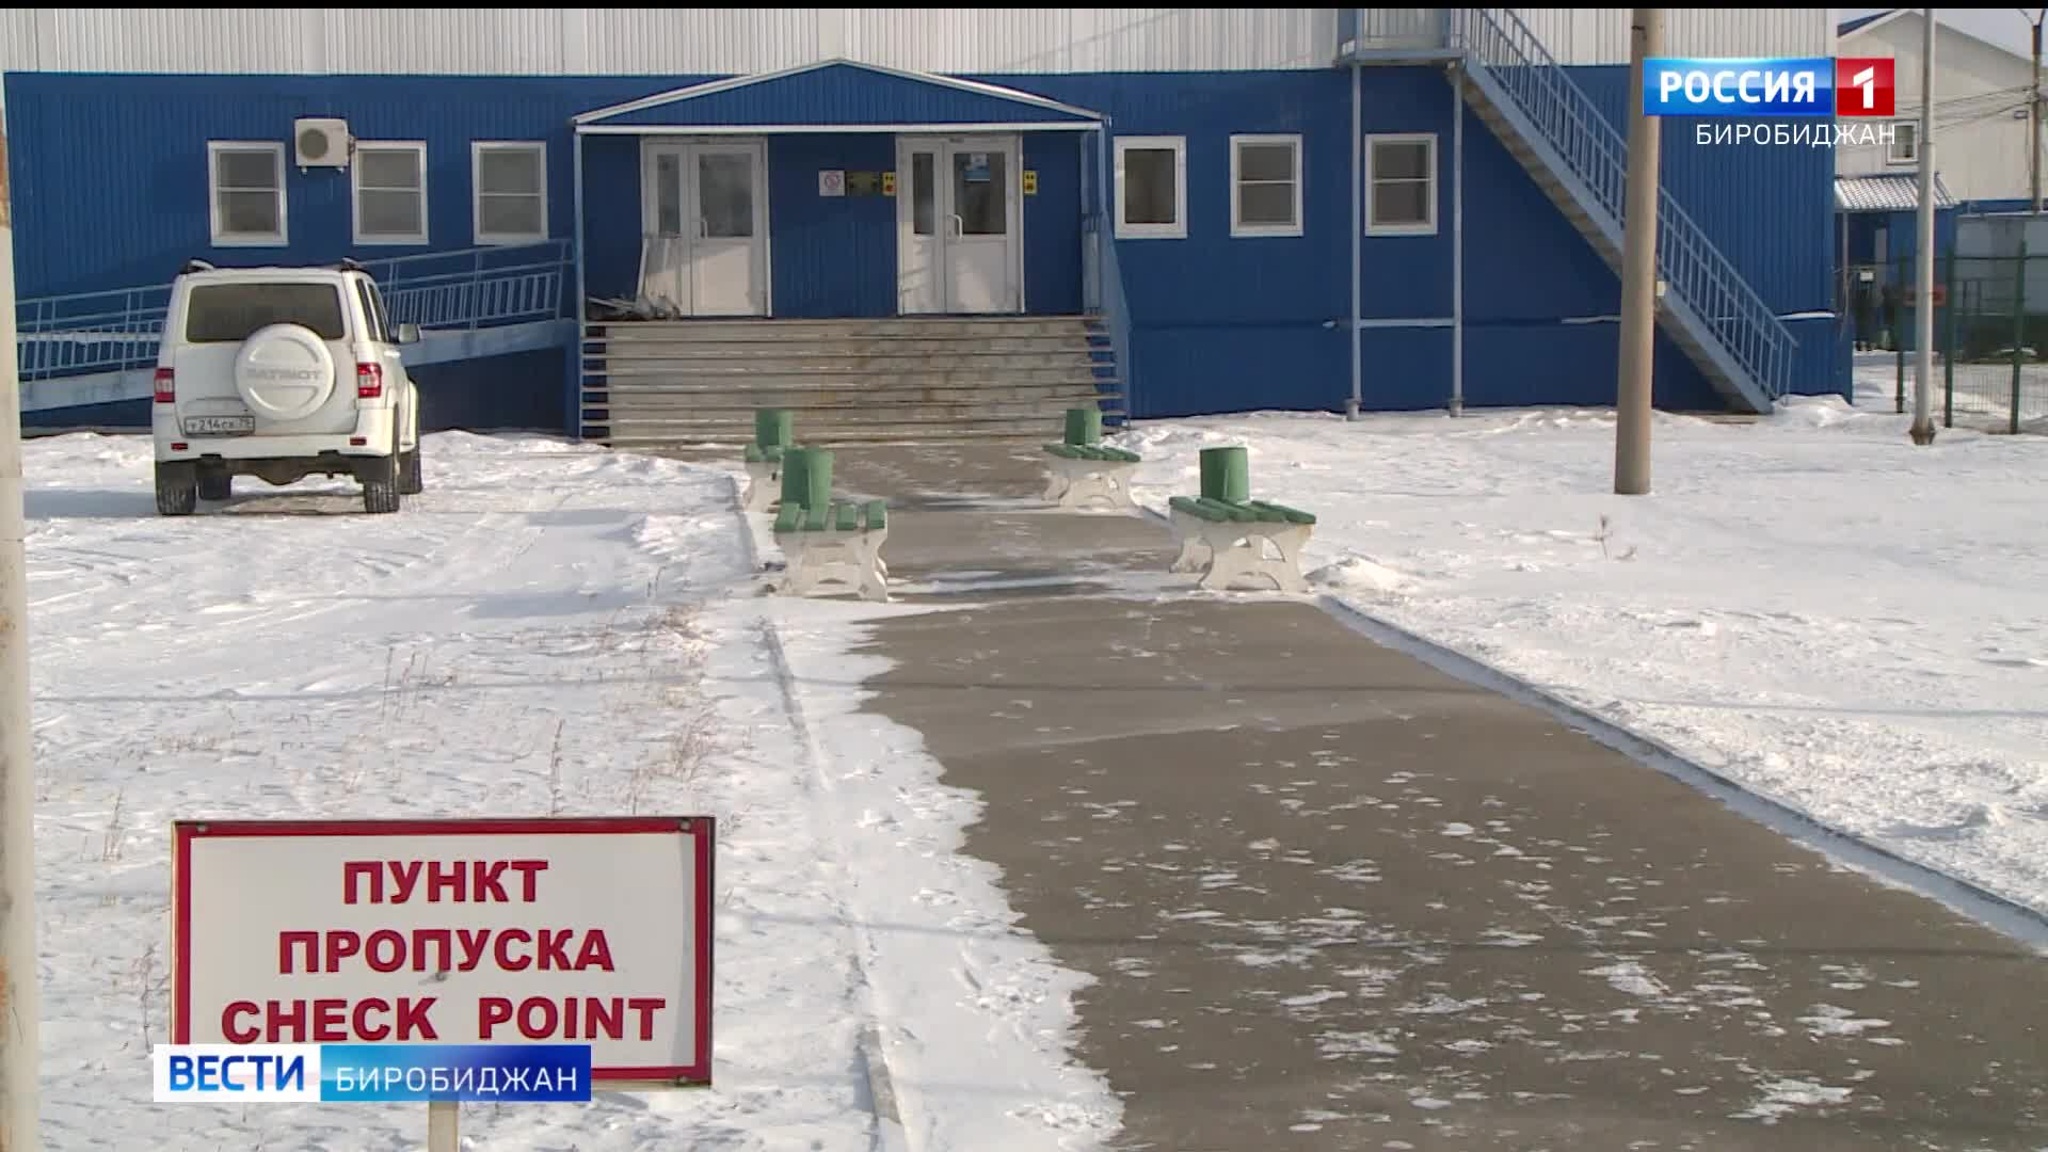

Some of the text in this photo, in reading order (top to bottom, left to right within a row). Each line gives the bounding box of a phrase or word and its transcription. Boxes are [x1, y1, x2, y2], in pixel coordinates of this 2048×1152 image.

[343, 860, 549, 904] ПУНКТ
[279, 928, 615, 974] ПРОПУСКА
[221, 997, 666, 1043] CHECK POINT
